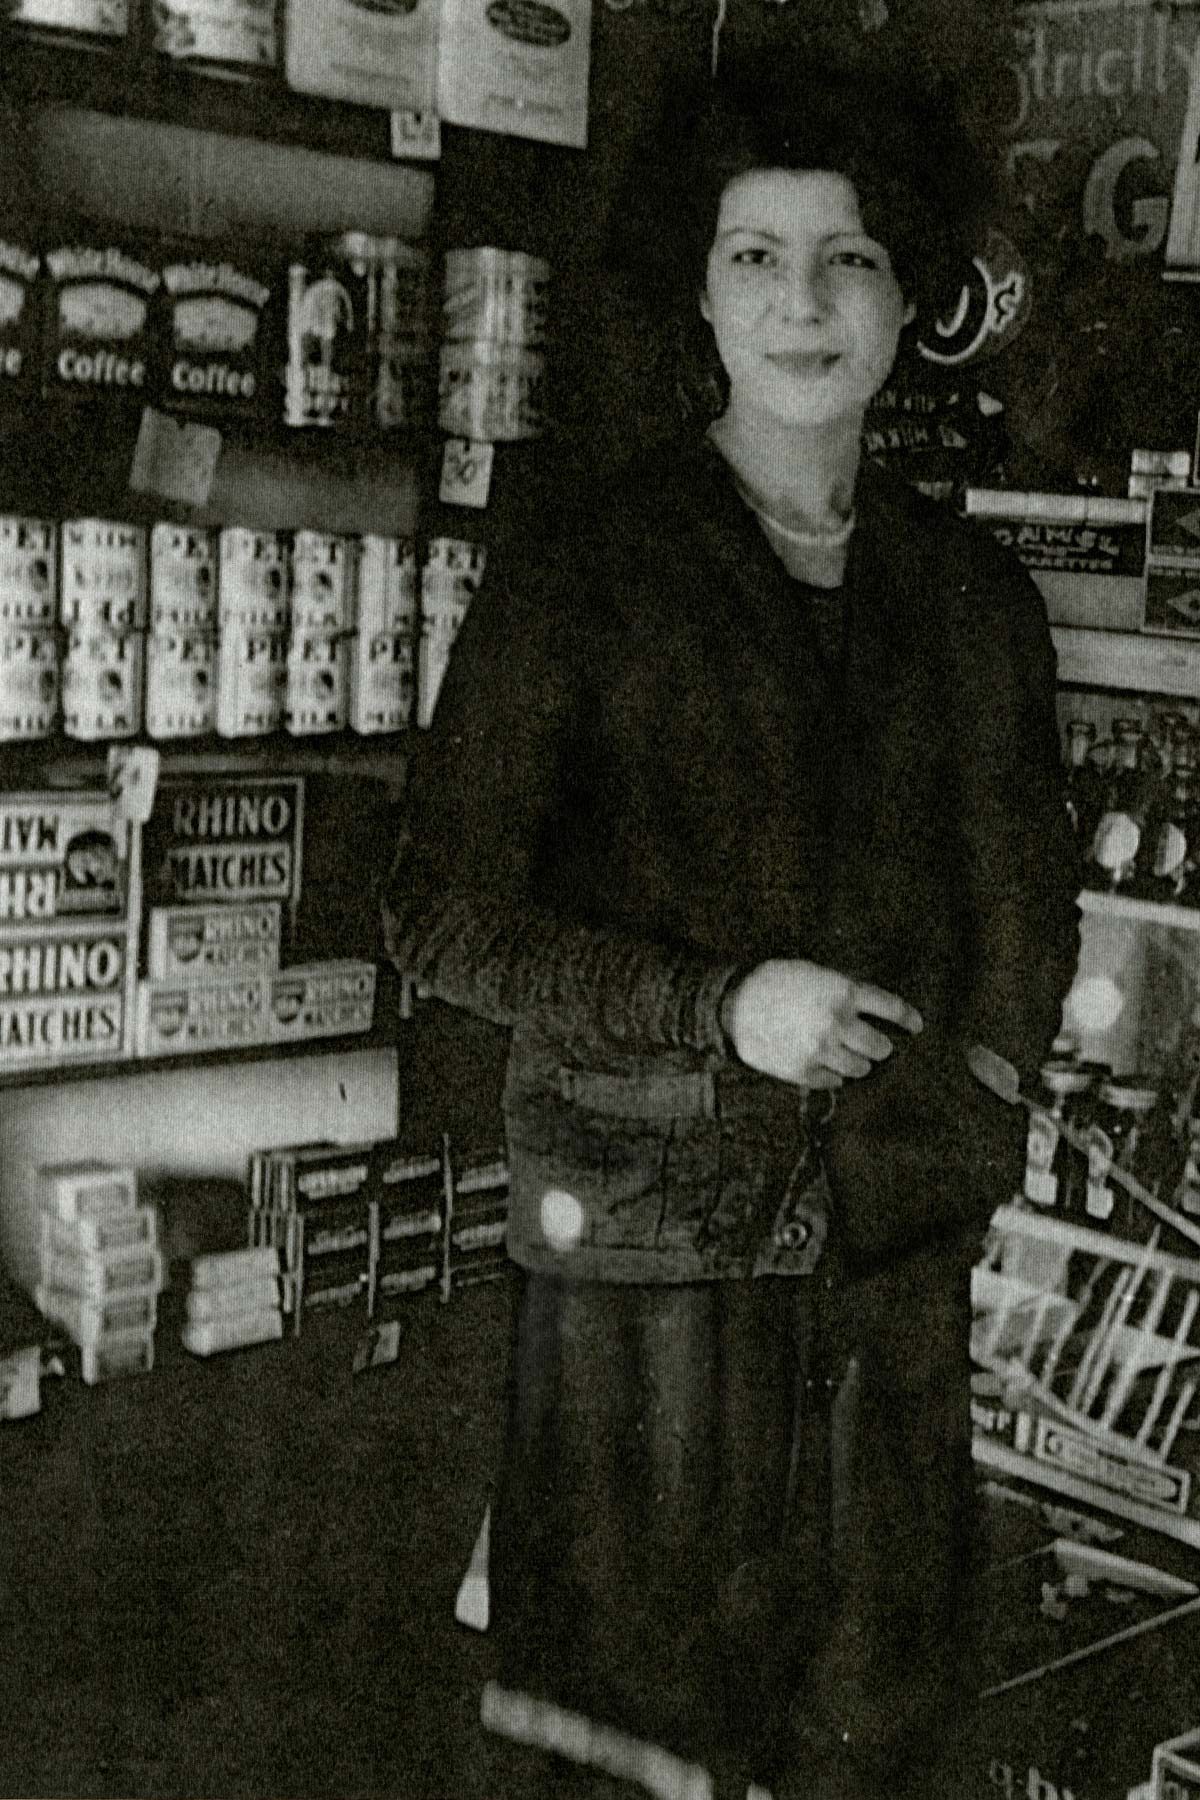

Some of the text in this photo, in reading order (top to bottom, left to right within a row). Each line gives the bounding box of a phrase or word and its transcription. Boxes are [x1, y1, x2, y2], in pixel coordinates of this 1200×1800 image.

[58, 350, 145, 387] Coffee
[172, 361, 256, 397] Coffee
[174, 794, 290, 837] RHINO
[169, 853, 288, 894] MATCHES
[1, 1007, 117, 1047] ATCHES
